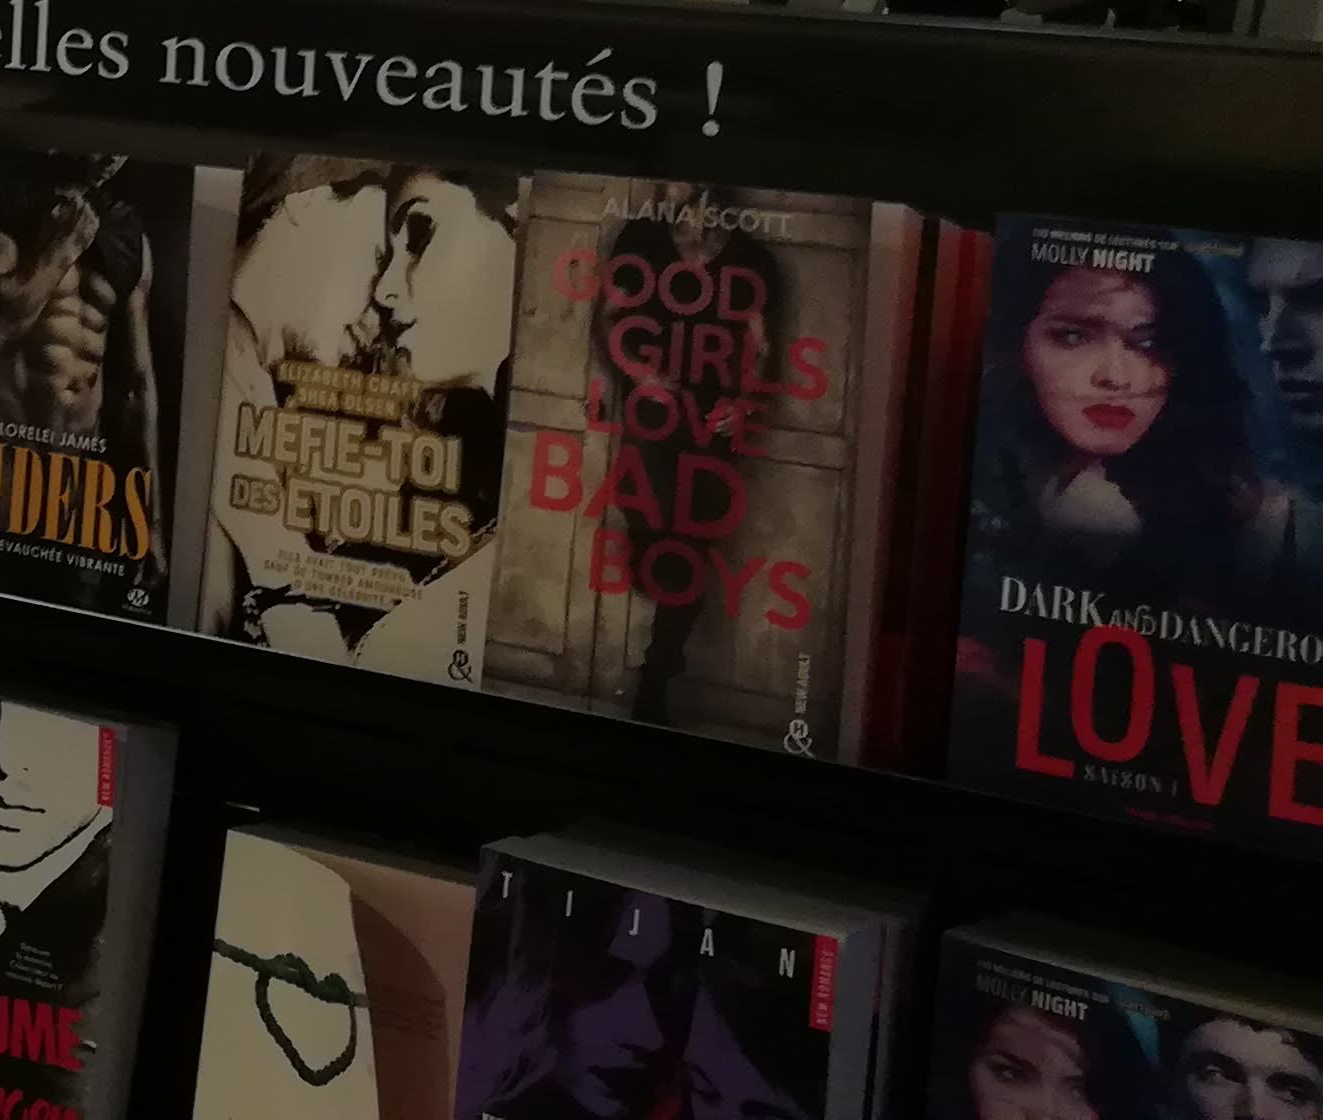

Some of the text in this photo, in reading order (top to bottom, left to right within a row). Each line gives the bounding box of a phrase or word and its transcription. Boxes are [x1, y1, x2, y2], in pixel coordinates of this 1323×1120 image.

[160, 26, 659, 131] nouveautés
[701, 62, 724, 138] !
[602, 197, 794, 237] ALANA SCOTT
[554, 249, 766, 323] GOOD
[1030, 242, 1156, 274] MOLLY NIGHT
[609, 315, 830, 402] GIRLS
[59, 431, 107, 454] JAMES
[586, 378, 770, 458] LOVE
[231, 476, 281, 513] DES
[529, 431, 749, 540] BAD
[66, 554, 125, 577] VIBRANTE
[588, 529, 813, 632] BOYS
[1000, 576, 1104, 628] DARK
[1016, 623, 1323, 827] LOVE
[1031, 989, 1089, 1021] NIGHT
